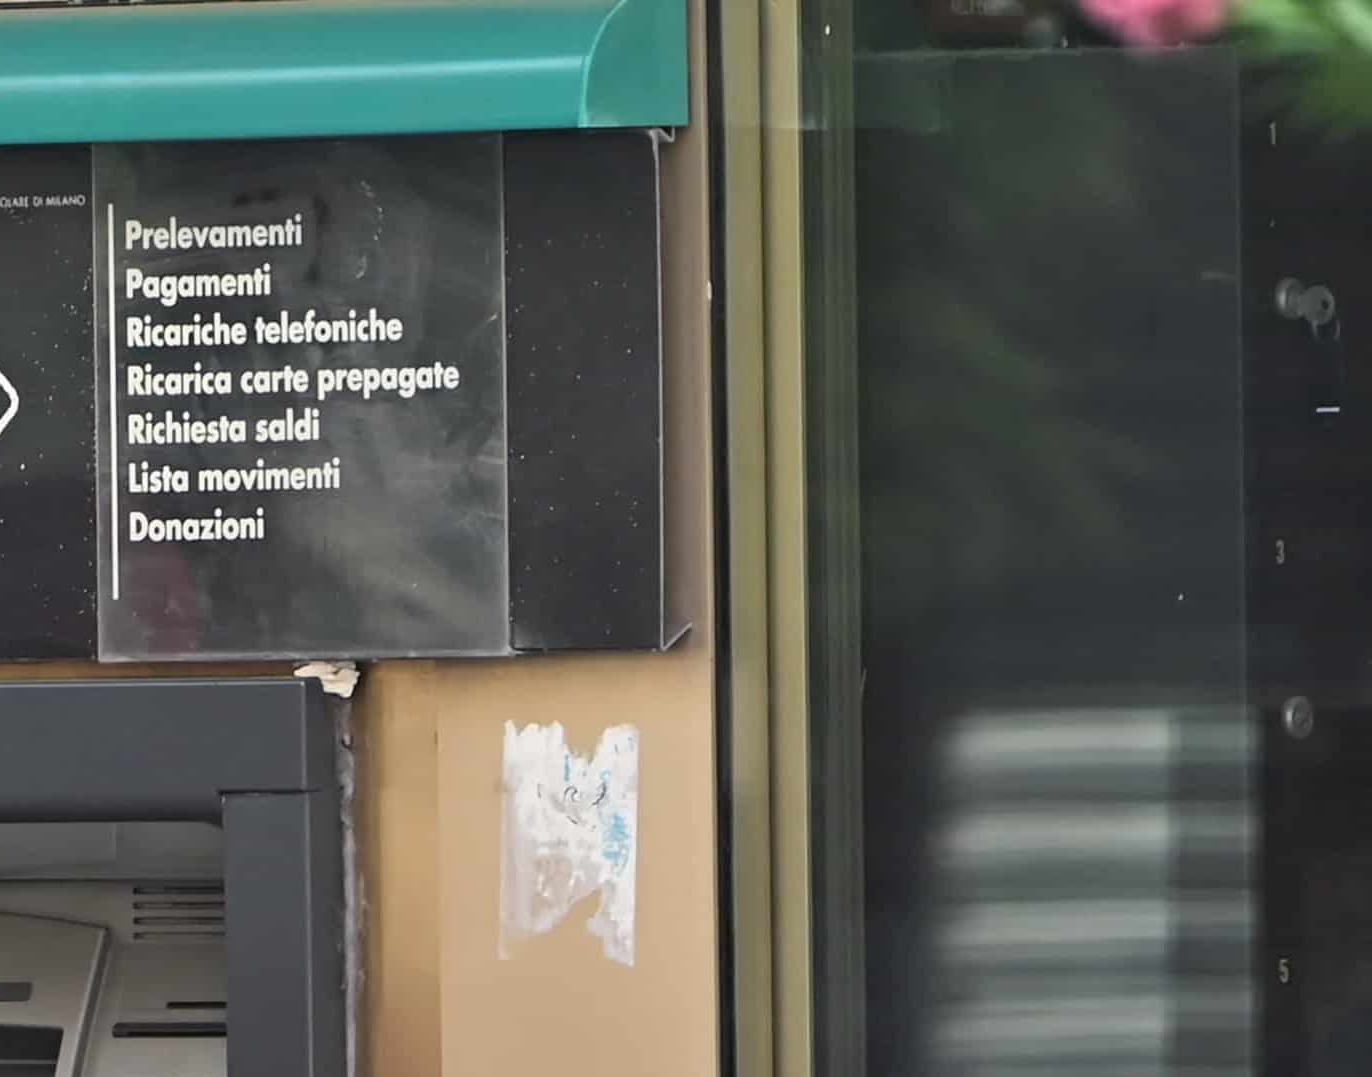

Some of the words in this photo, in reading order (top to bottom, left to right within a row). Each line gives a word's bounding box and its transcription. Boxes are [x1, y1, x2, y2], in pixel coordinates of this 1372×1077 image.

[32, 196, 43, 207] DI
[45, 194, 86, 207] MILANO
[125, 213, 303, 250] Prelevamenti
[126, 262, 272, 307] Pagamenti
[127, 312, 248, 348] Ricariche
[254, 308, 404, 344] telefoniche
[127, 361, 233, 396] Ricarica
[240, 365, 310, 394] carte
[317, 361, 461, 401] prepagate
[128, 410, 247, 445] Richiesta
[255, 407, 321, 443] saldi
[128, 460, 190, 493] Lista
[197, 456, 341, 492] movimenti
[129, 507, 265, 542] Donazioni
